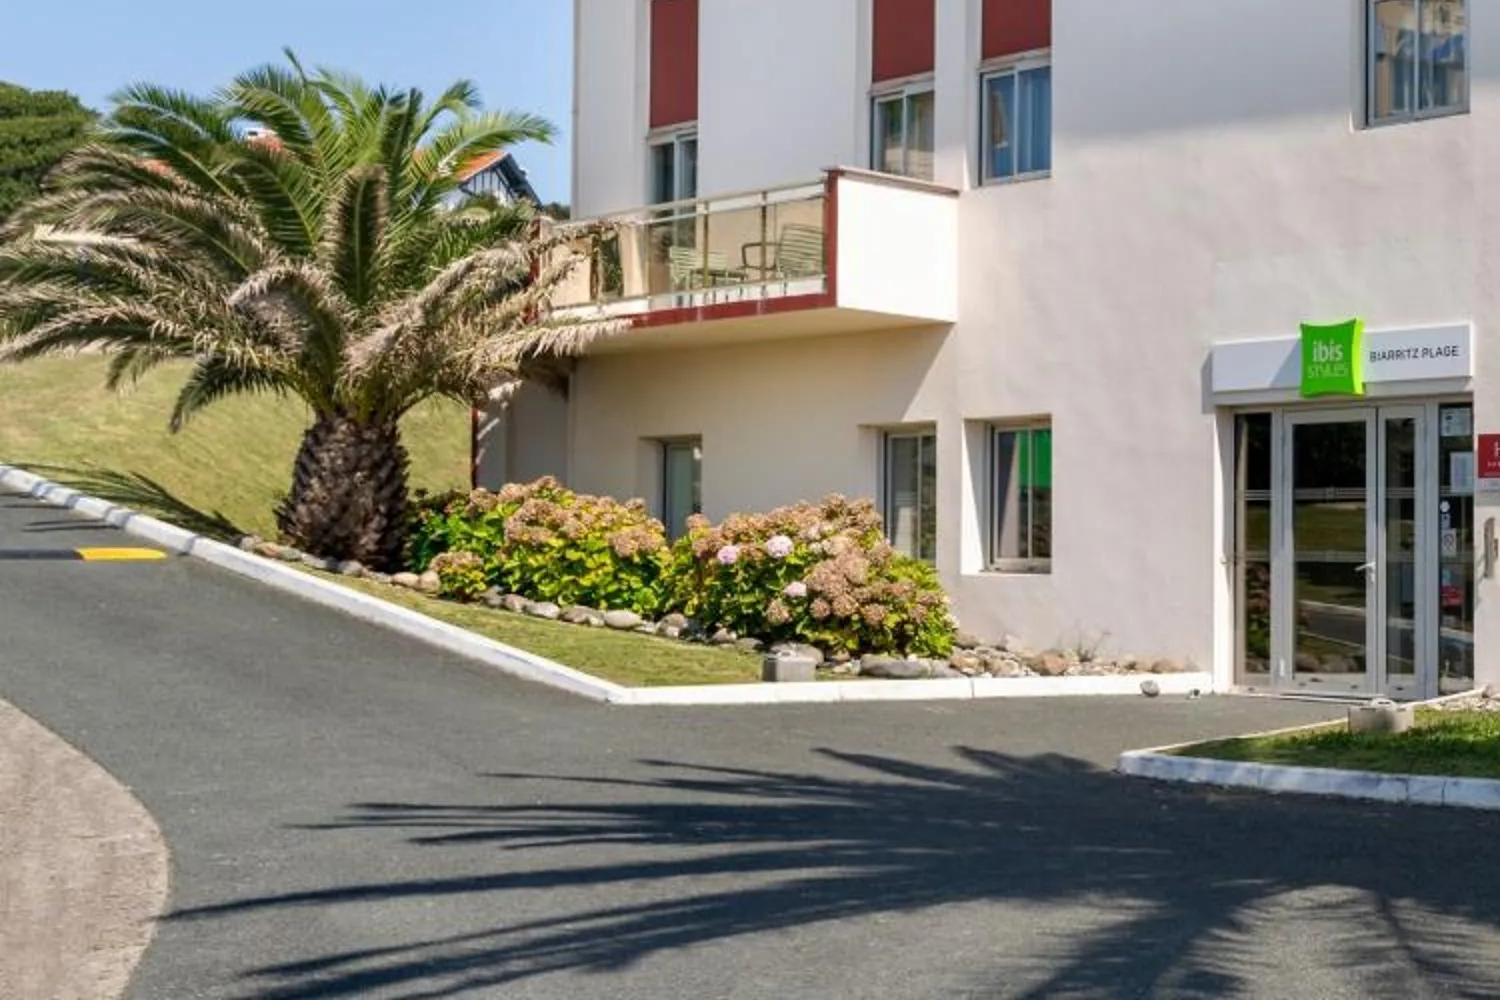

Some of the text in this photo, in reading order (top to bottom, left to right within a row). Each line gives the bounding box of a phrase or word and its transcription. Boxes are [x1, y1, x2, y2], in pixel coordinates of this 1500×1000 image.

[1312, 339, 1344, 363] ibis
[1369, 345, 1460, 362] BIARRITZ PLAGE
[1307, 362, 1348, 378] STYLES
